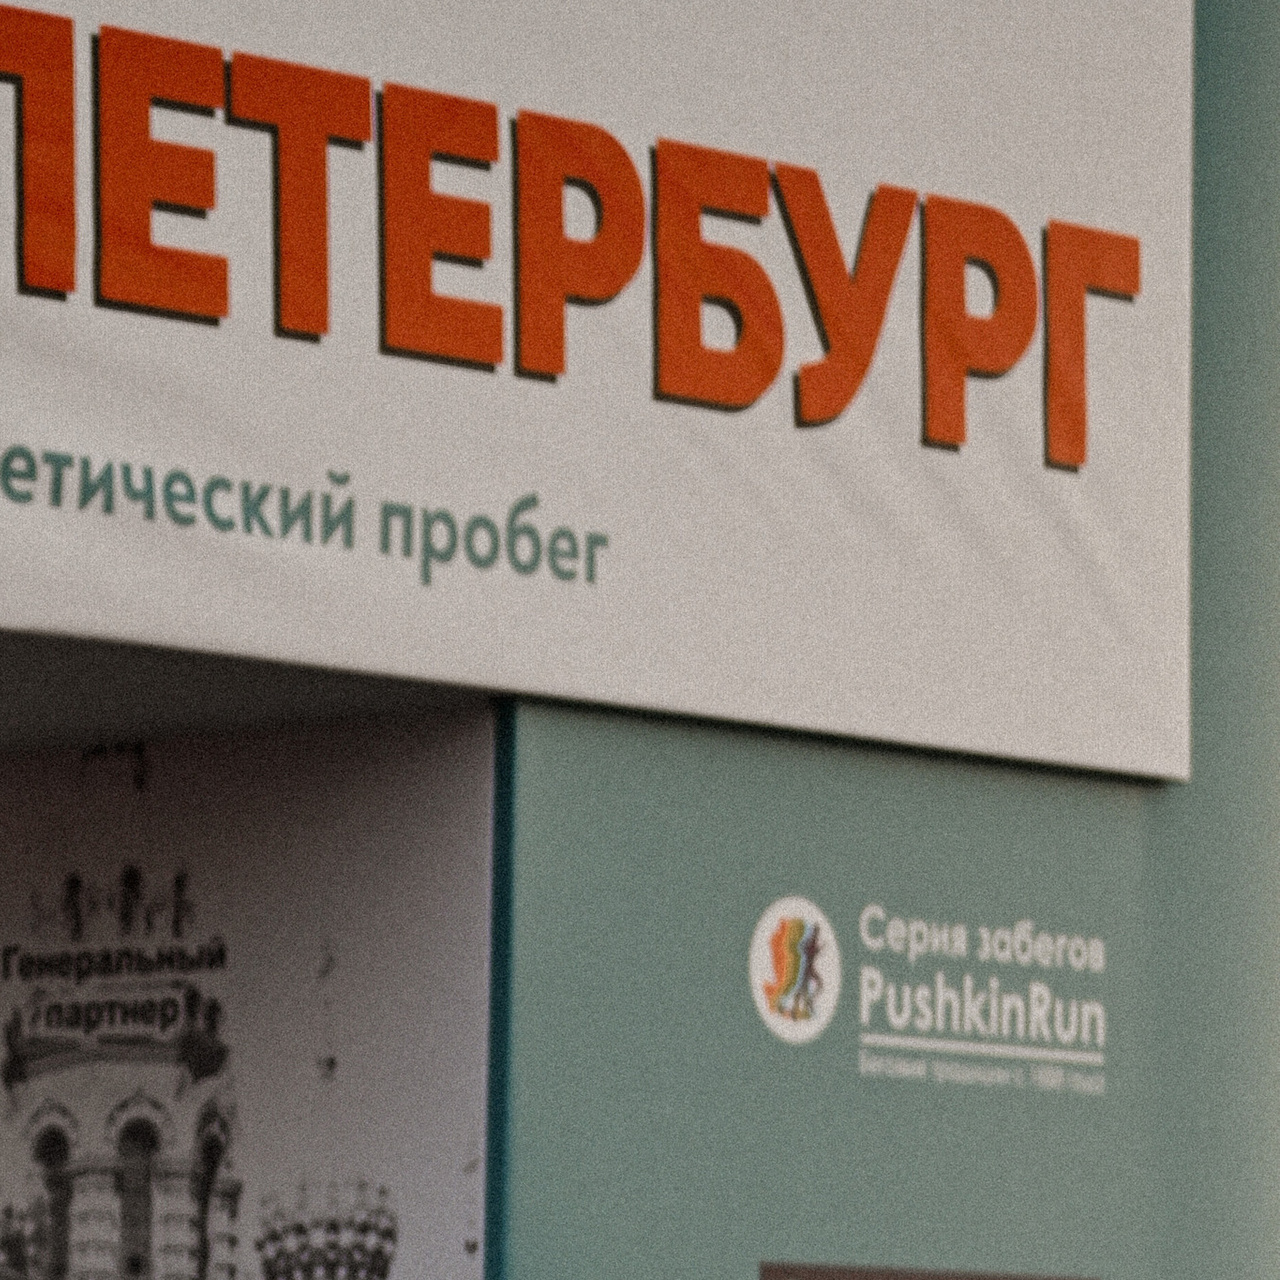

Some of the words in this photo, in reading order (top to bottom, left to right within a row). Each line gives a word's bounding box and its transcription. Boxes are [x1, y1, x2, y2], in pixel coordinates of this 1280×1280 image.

[377, 494, 610, 586] пробег
[2, 937, 227, 984] Генеральный
[859, 902, 968, 966] Серия
[978, 918, 1106, 974] забегов
[858, 964, 1106, 1048] PushkinRun
